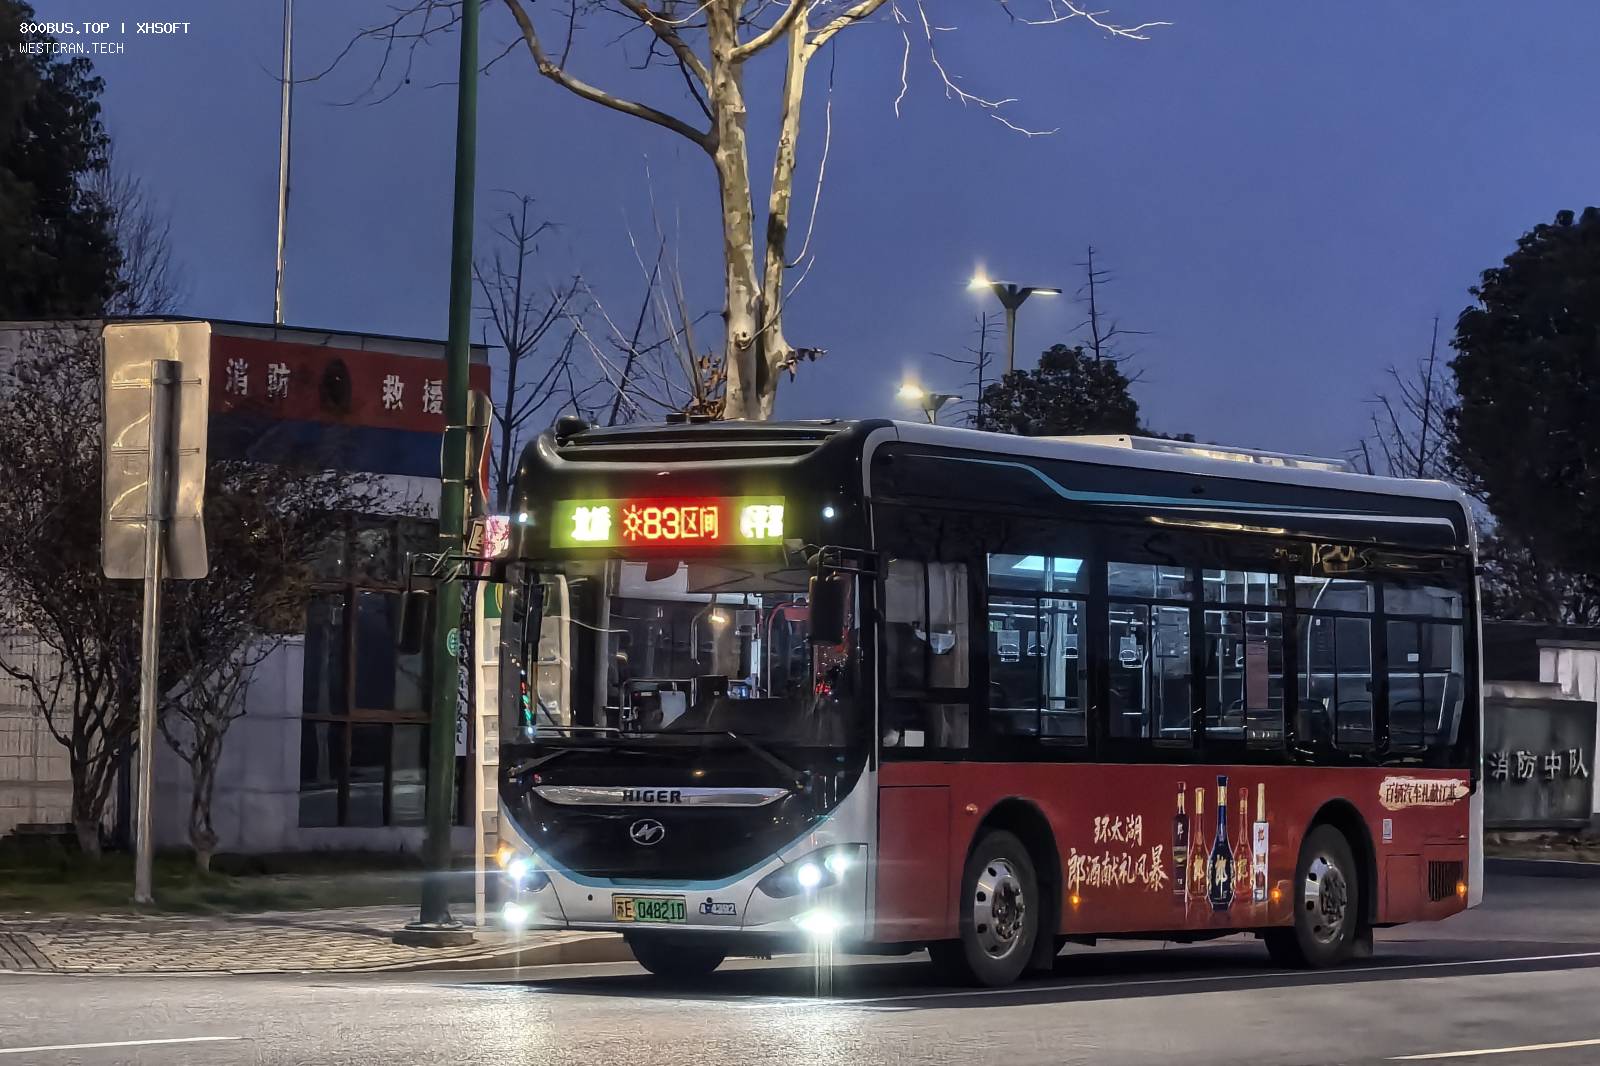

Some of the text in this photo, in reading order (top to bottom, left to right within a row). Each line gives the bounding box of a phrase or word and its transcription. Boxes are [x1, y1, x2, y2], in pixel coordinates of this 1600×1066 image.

[225, 357, 443, 415] 消防 救援
[1488, 747, 1590, 780] 消防中队
[622, 789, 682, 804] HIGER
[1093, 813, 1143, 849] 环太湖
[1066, 846, 1169, 893] 郎酒献礼风暴
